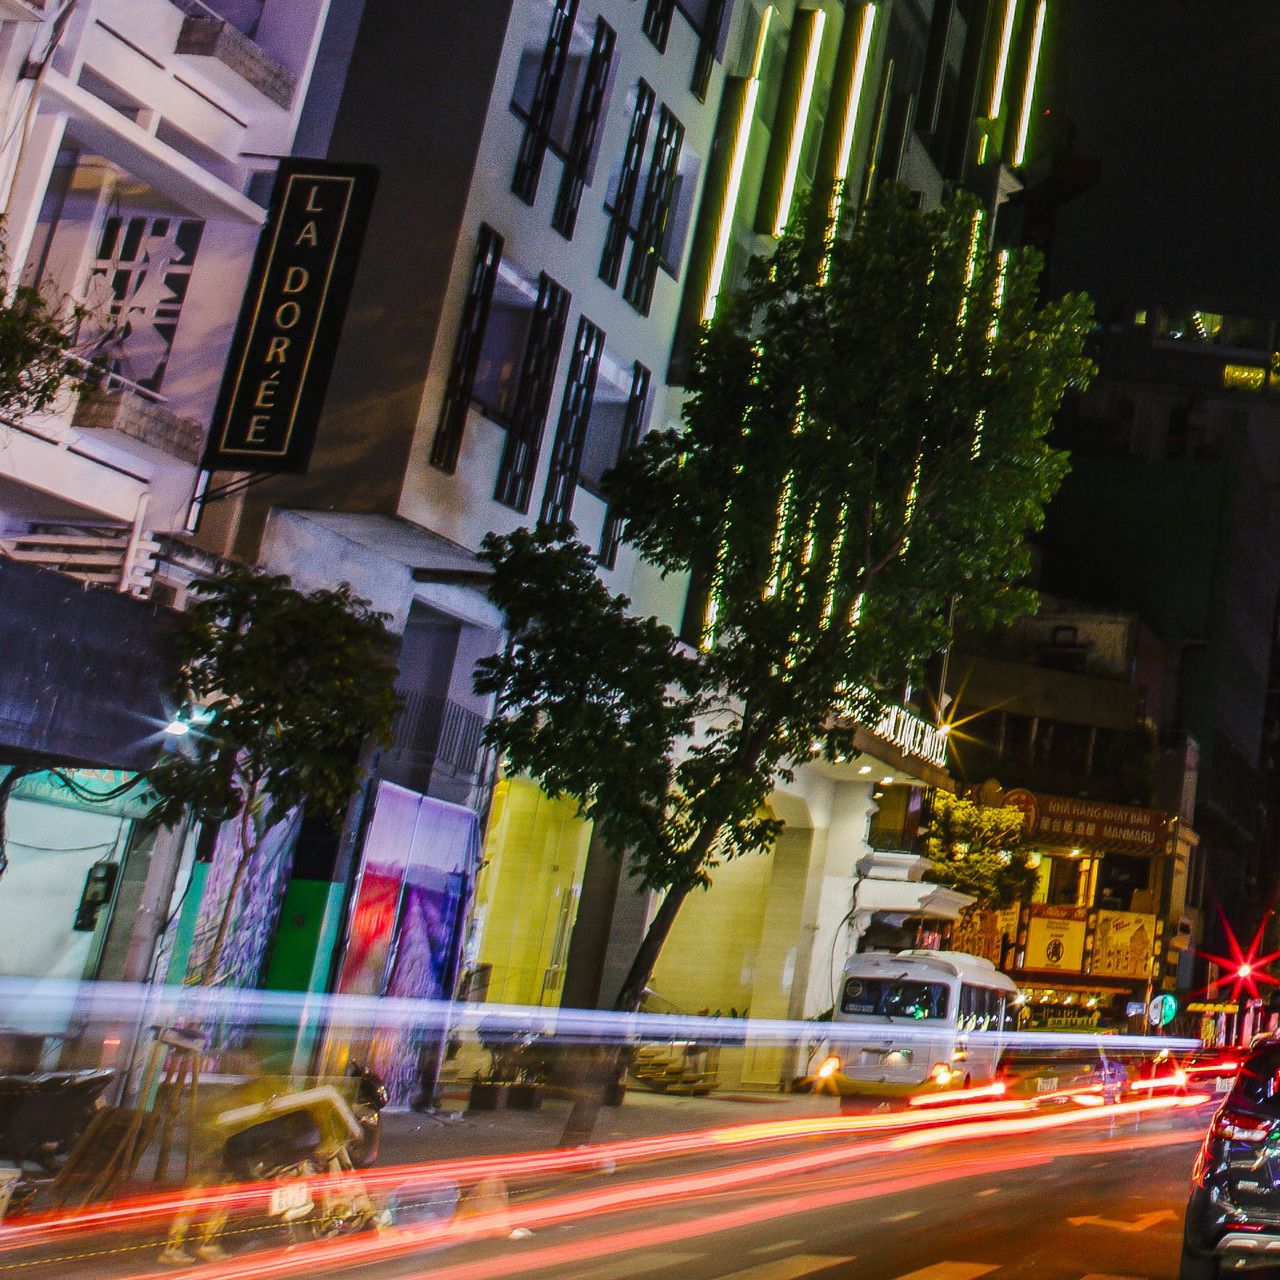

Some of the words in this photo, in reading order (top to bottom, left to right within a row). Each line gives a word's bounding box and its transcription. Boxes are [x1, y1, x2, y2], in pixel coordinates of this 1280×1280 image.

[295, 185, 323, 247] LA
[246, 266, 309, 443] DORÉE
[1103, 825, 1156, 844] MANMARU
